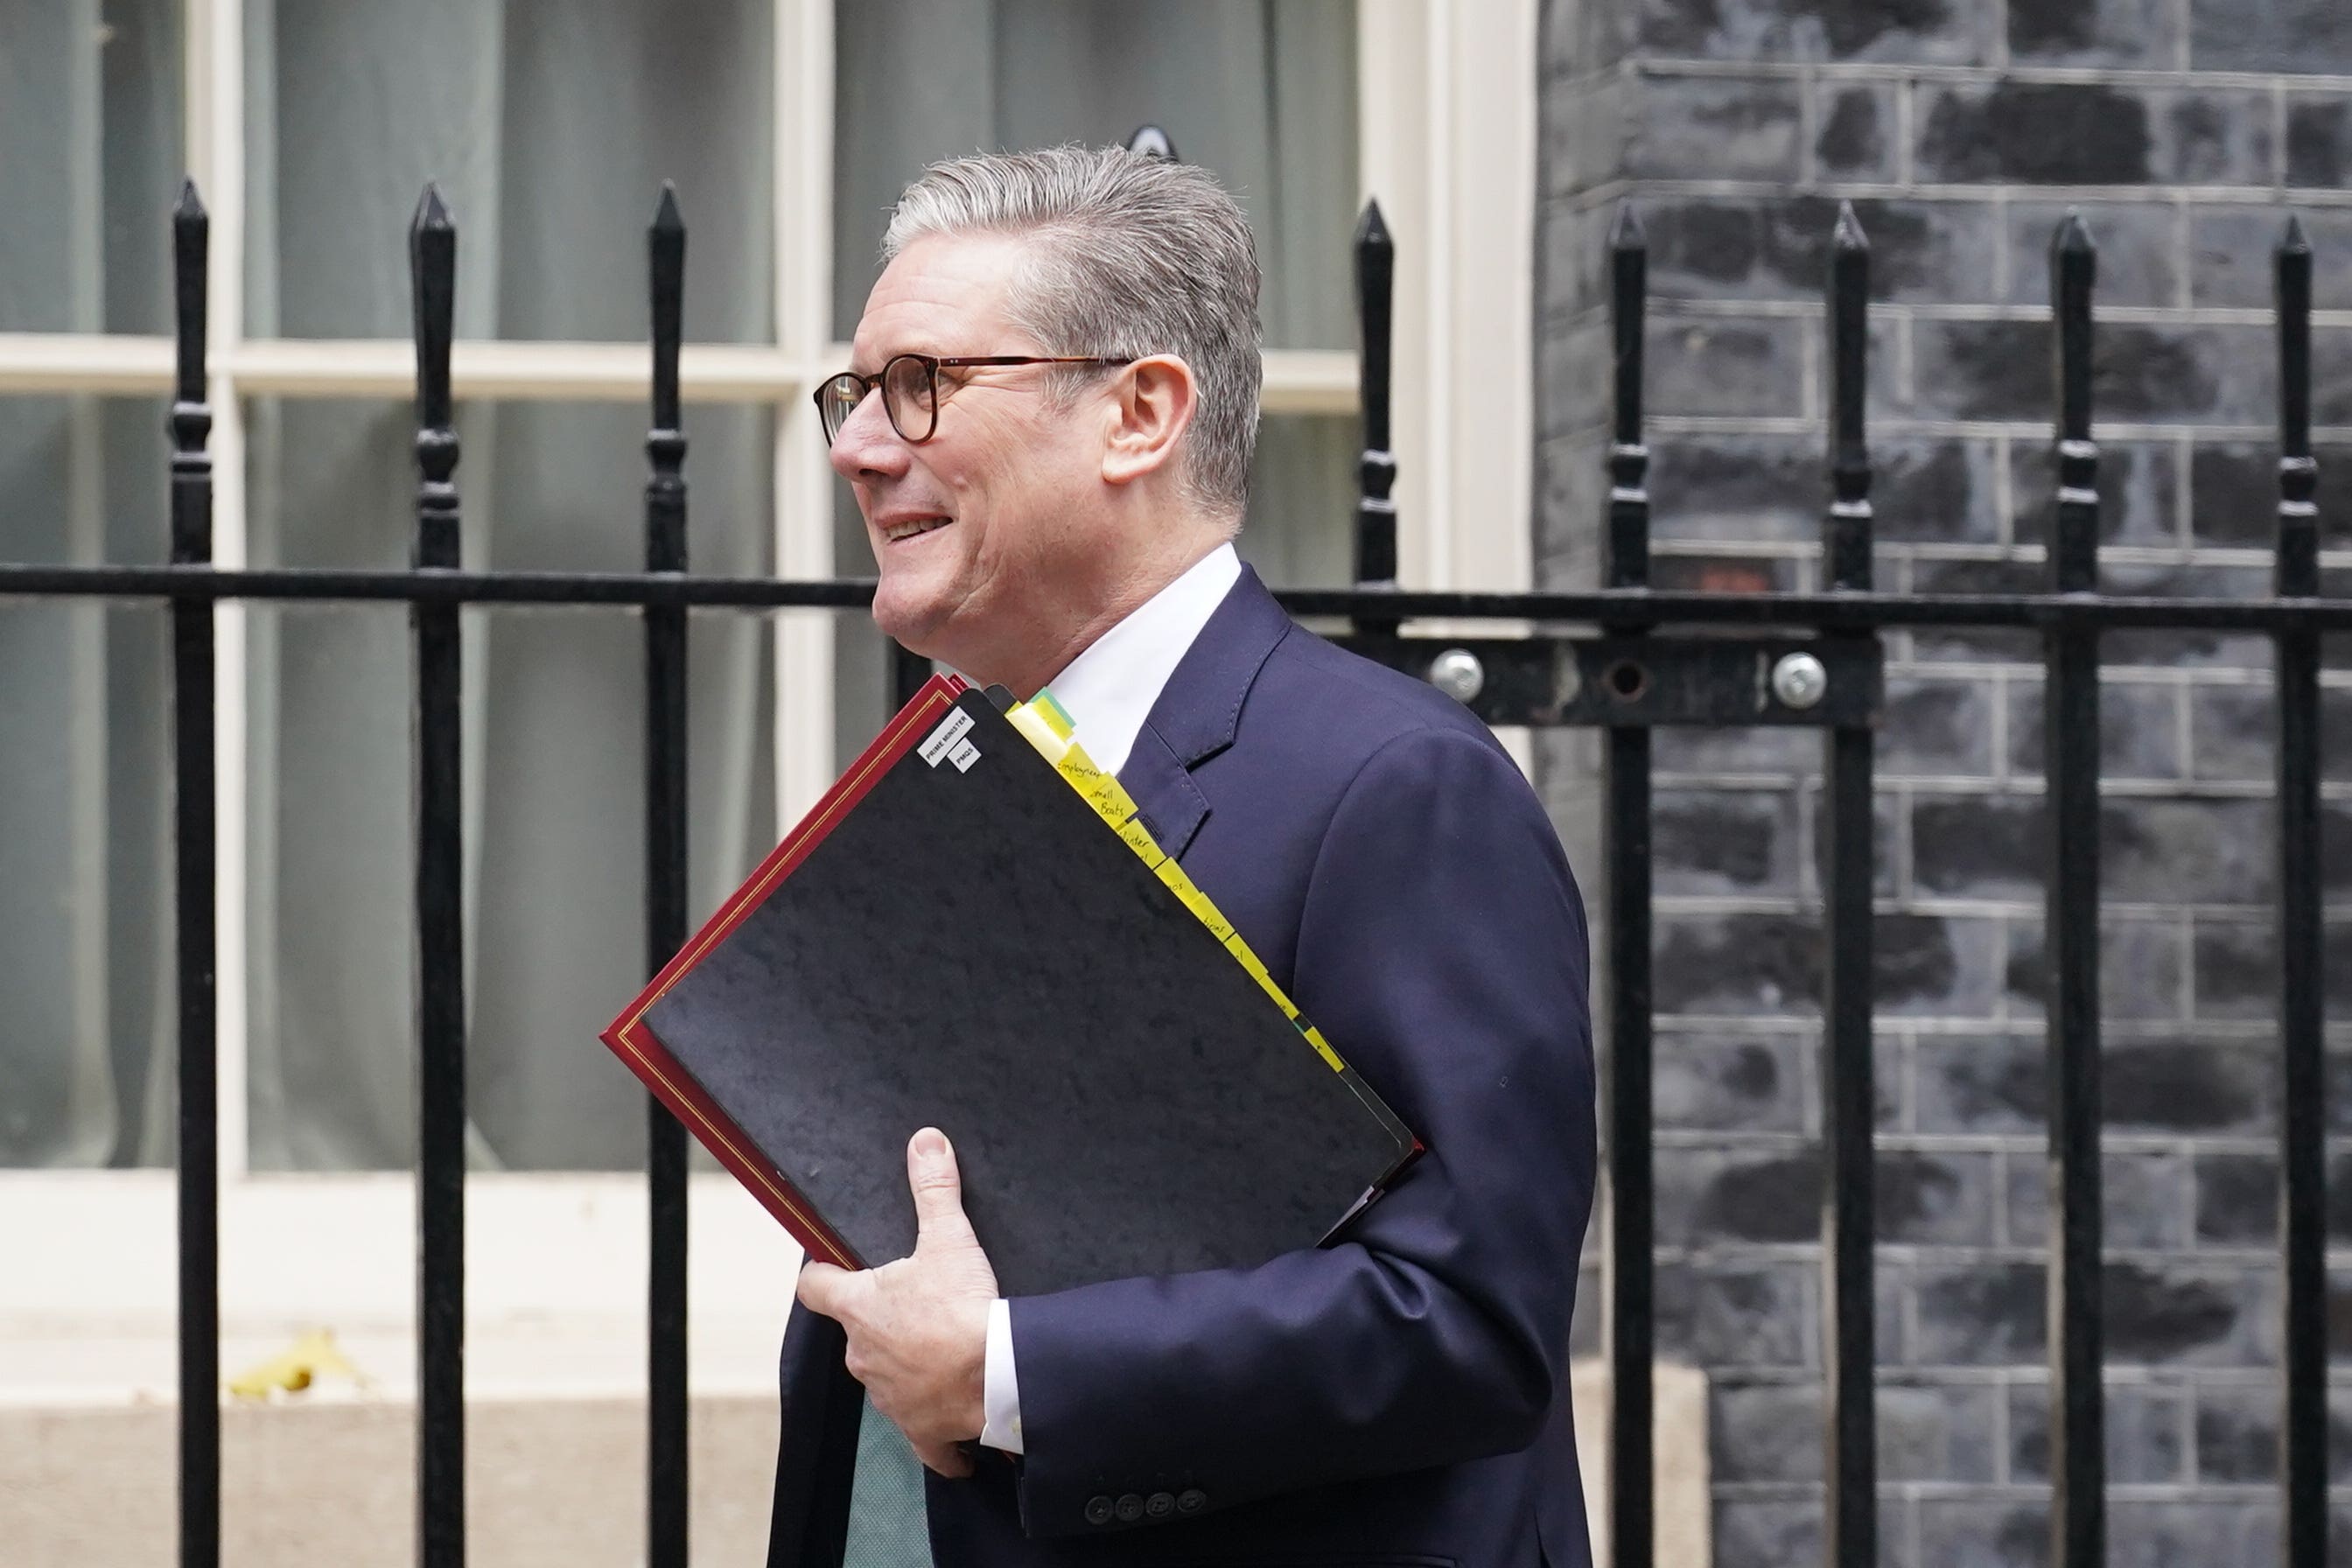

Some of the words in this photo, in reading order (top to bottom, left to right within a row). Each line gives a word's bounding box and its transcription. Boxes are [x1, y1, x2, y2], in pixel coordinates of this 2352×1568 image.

[926, 740, 944, 760] PRIME
[942, 715, 967, 742] MINISTER
[1101, 802, 1124, 816] Boats
